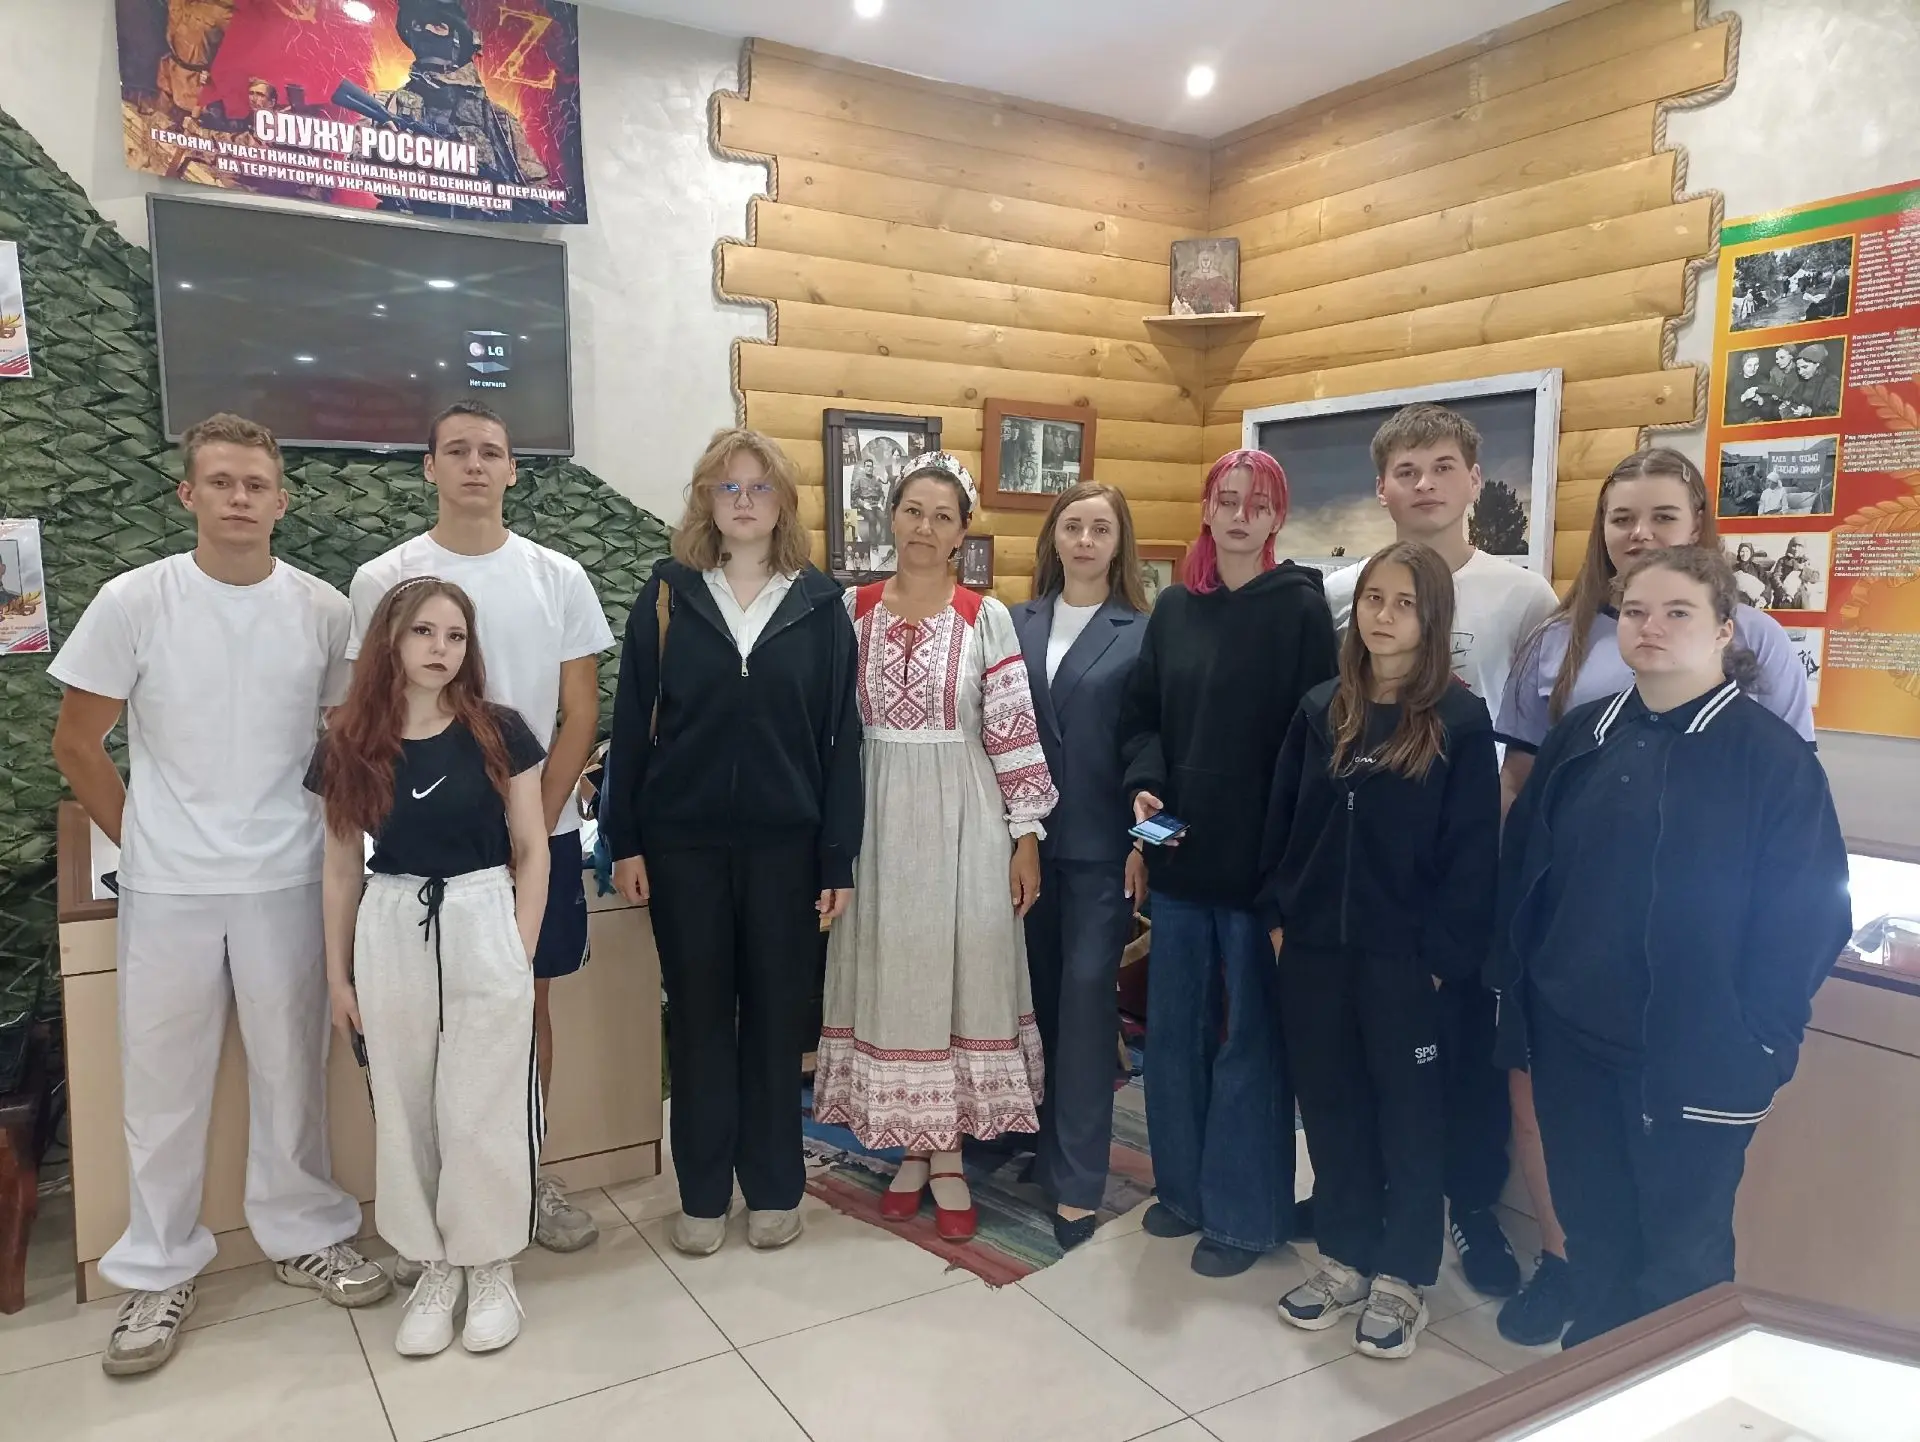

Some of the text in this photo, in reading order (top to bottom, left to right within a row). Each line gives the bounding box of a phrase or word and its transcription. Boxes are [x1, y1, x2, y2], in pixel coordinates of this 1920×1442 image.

[493, 6, 556, 89] Z
[151, 128, 567, 201] ГЕРОЯМ, УЧАСТНИКАМ СПЕЦИАЛЬНОЙ ВОЕННОЙ ОПЕРАЦИИ
[256, 110, 478, 175] СЛУЖУ РОССИИ!
[218, 158, 512, 211] НА ТЕРРИТОРИИ УКРАИНЫ ПОСВЯЩАЕТСЯ
[487, 345, 504, 356] LG
[469, 379, 507, 388] Нет сигнала
